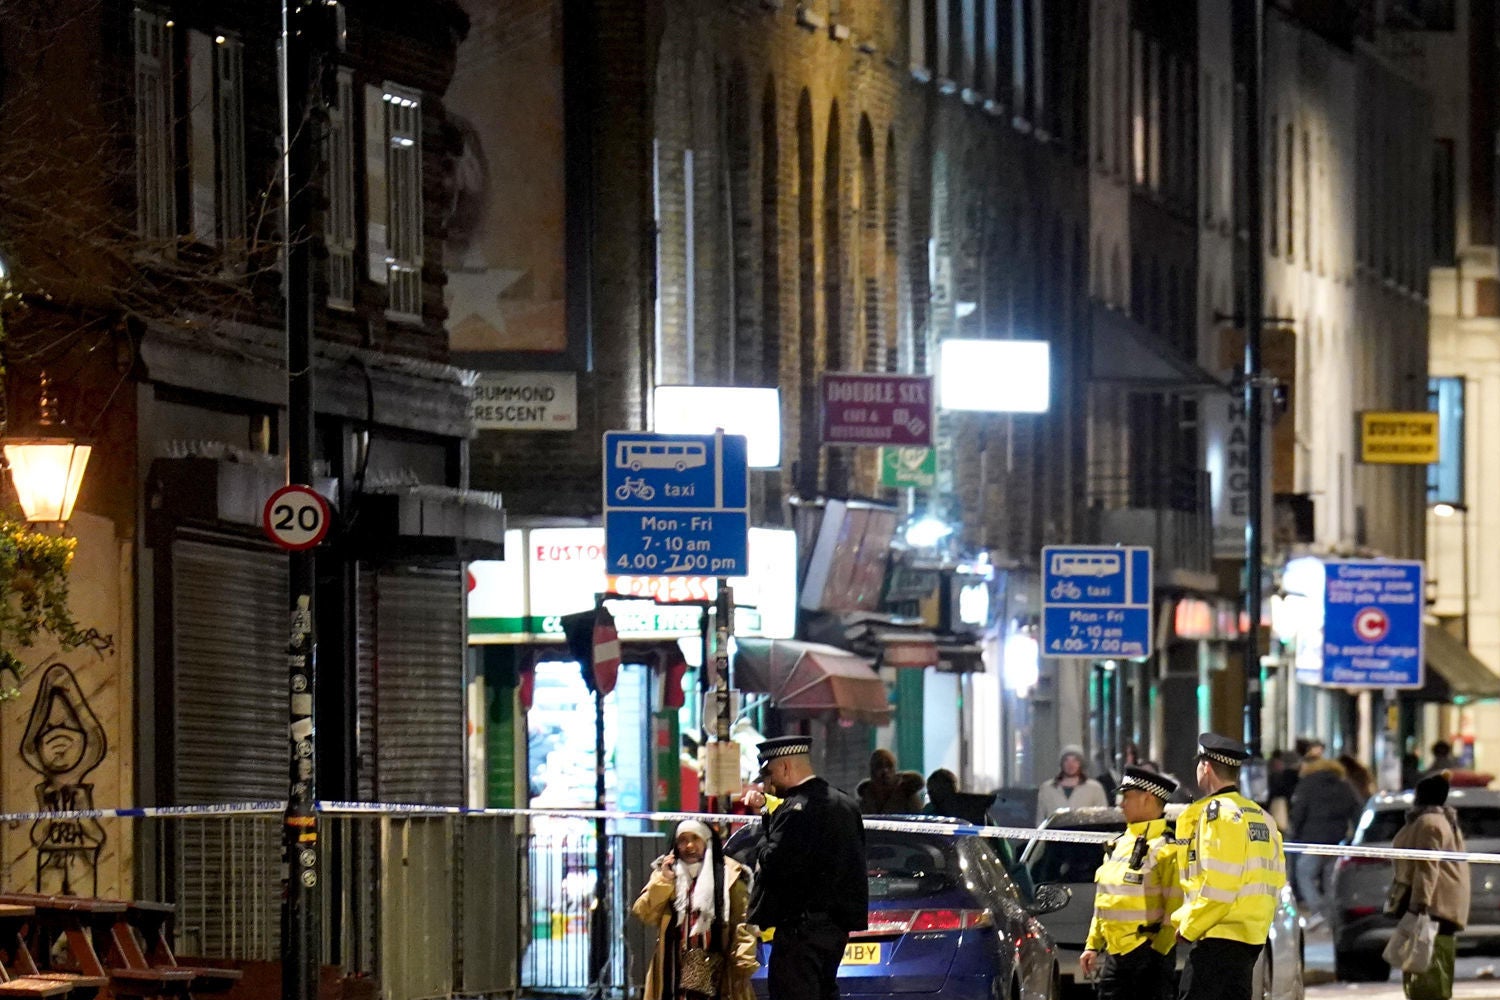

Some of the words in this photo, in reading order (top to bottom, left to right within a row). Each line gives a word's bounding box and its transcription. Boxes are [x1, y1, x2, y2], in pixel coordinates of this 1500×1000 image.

[473, 386, 555, 402] RUMMOND
[827, 381, 895, 403] DOUBLE
[899, 382, 926, 404] SIX
[665, 482, 695, 497] taxi
[274, 505, 319, 531] 20
[641, 517, 677, 531] Mon
[691, 517, 712, 531] Fri
[686, 540, 711, 551] am
[617, 554, 708, 569] 4.00-700
[711, 558, 736, 571] pm
[1087, 585, 1111, 597] taxi
[1069, 611, 1098, 622] Mon
[1106, 610, 1124, 622] Fri
[1103, 628, 1123, 637] am
